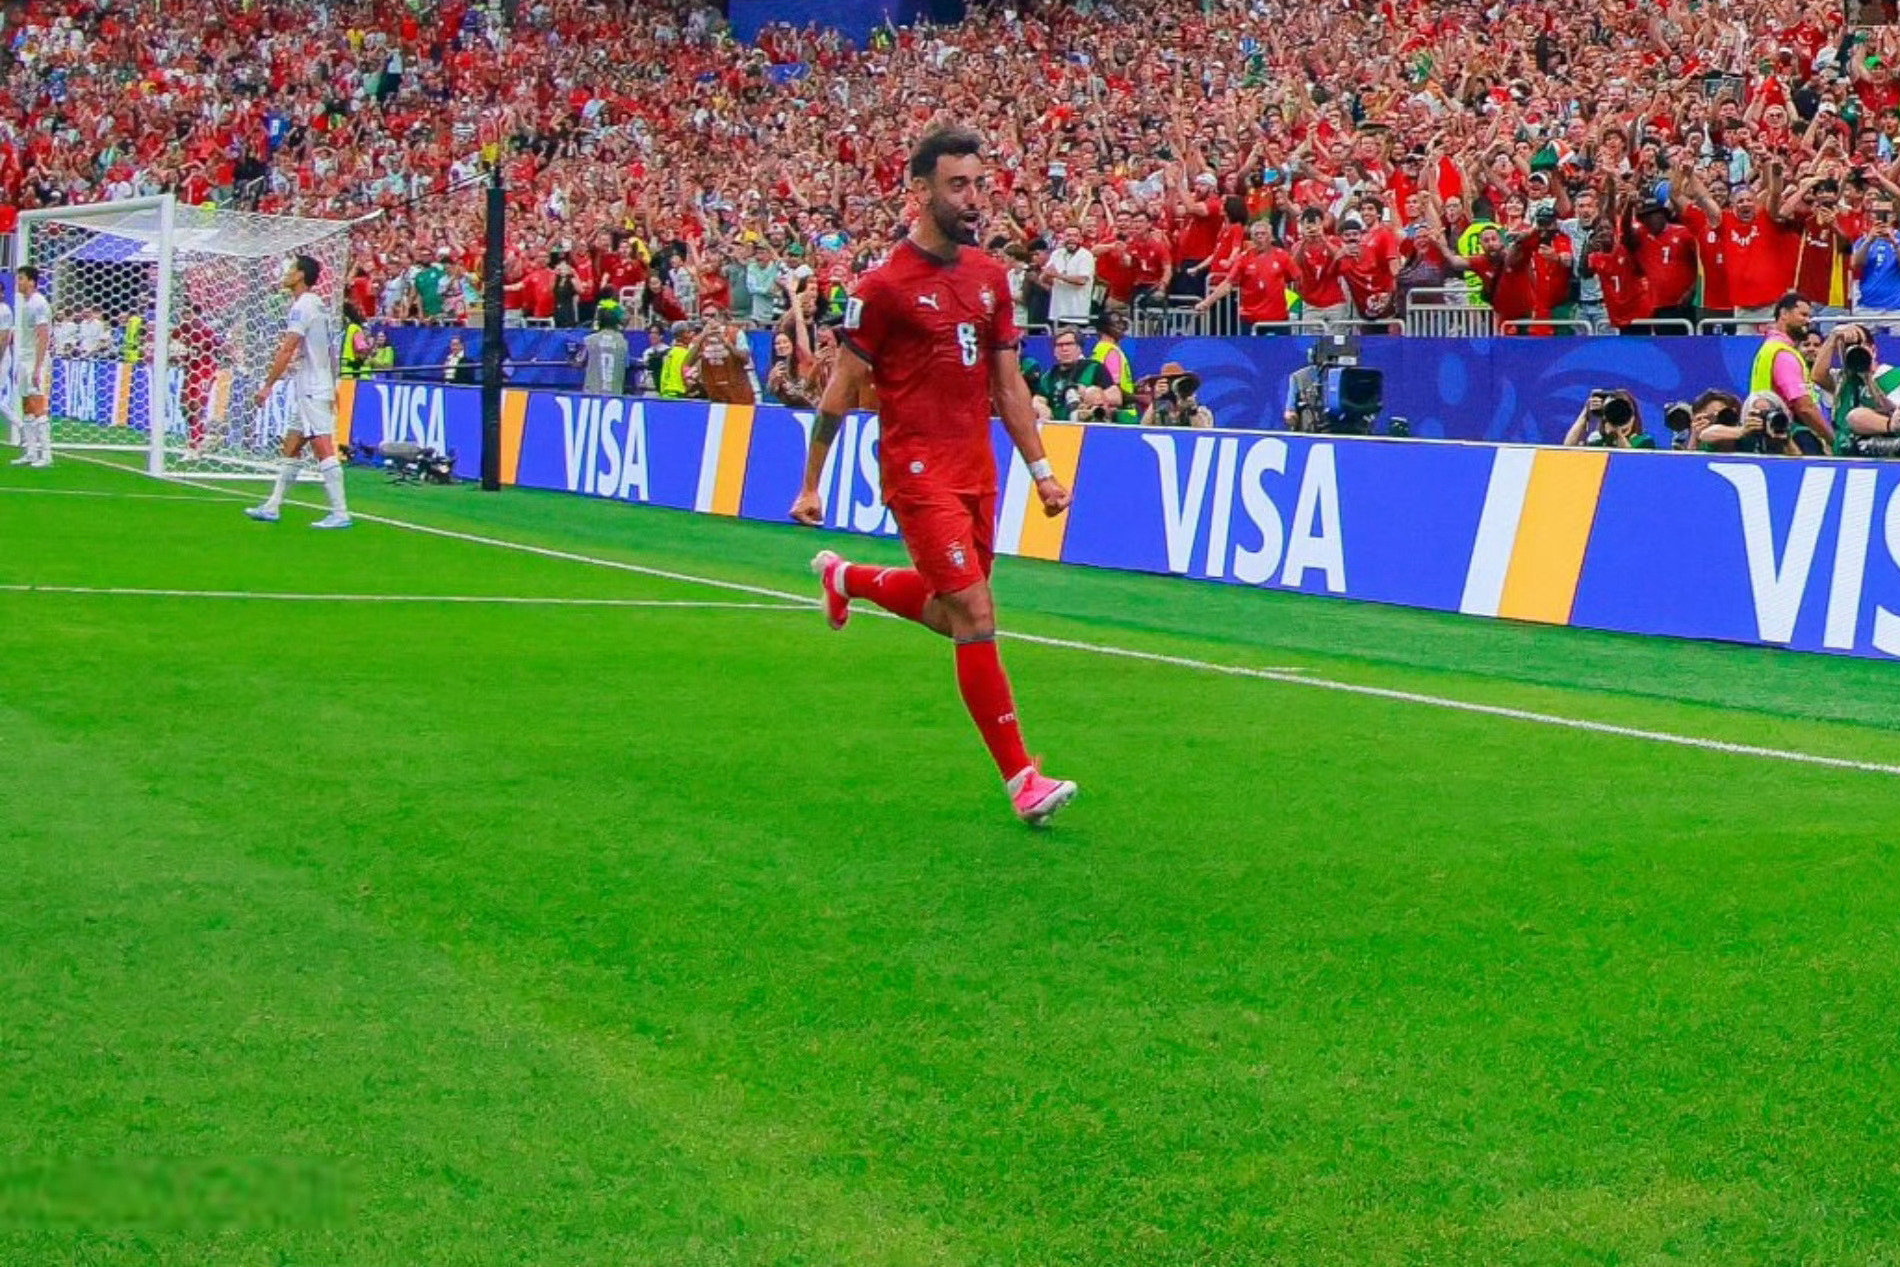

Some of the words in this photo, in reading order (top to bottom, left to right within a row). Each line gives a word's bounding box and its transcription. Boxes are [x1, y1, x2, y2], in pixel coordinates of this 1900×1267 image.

[375, 384, 447, 456] VISA
[555, 396, 649, 501] VISA
[792, 412, 899, 535] VIS
[1141, 434, 1347, 593] VISA
